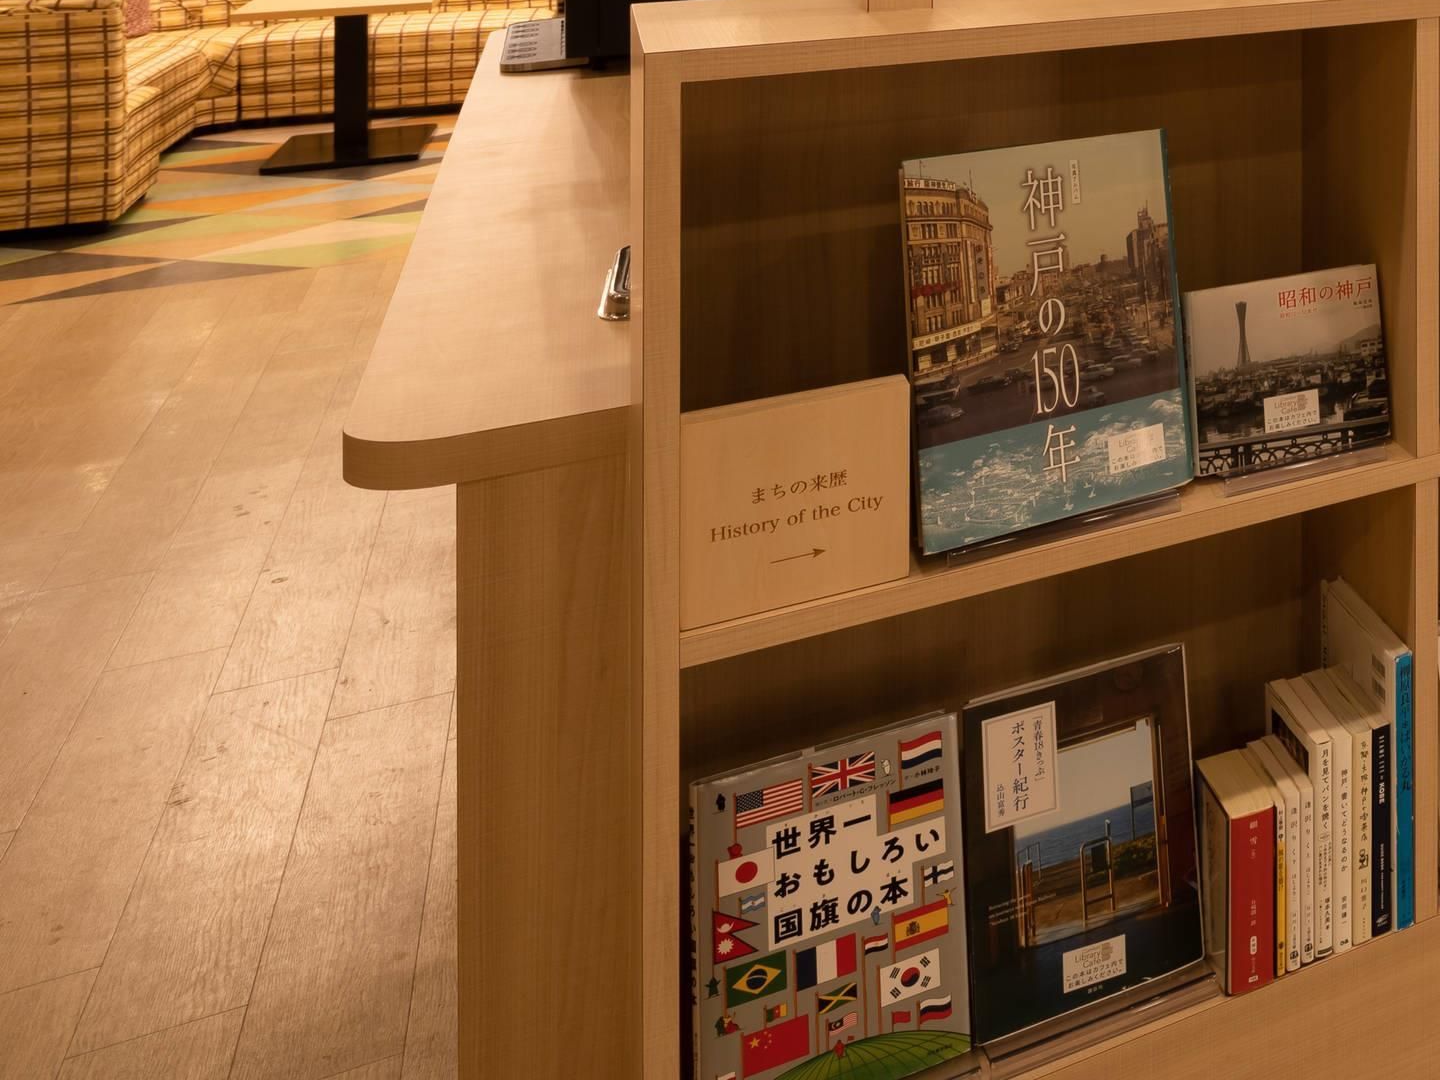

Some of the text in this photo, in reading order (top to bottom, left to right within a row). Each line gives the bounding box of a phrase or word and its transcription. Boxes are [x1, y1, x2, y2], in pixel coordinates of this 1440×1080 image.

[1278, 276, 1373, 309] 昭和の神戸
[1021, 167, 1081, 483] 神戸の150年
[752, 470, 848, 504] まちの来歴
[711, 496, 884, 542] History of the City
[1011, 720, 1030, 812] ポスター紀行
[772, 814, 871, 860] 世界一
[774, 829, 940, 898] おもしろい
[774, 876, 909, 944] 国旗の本
